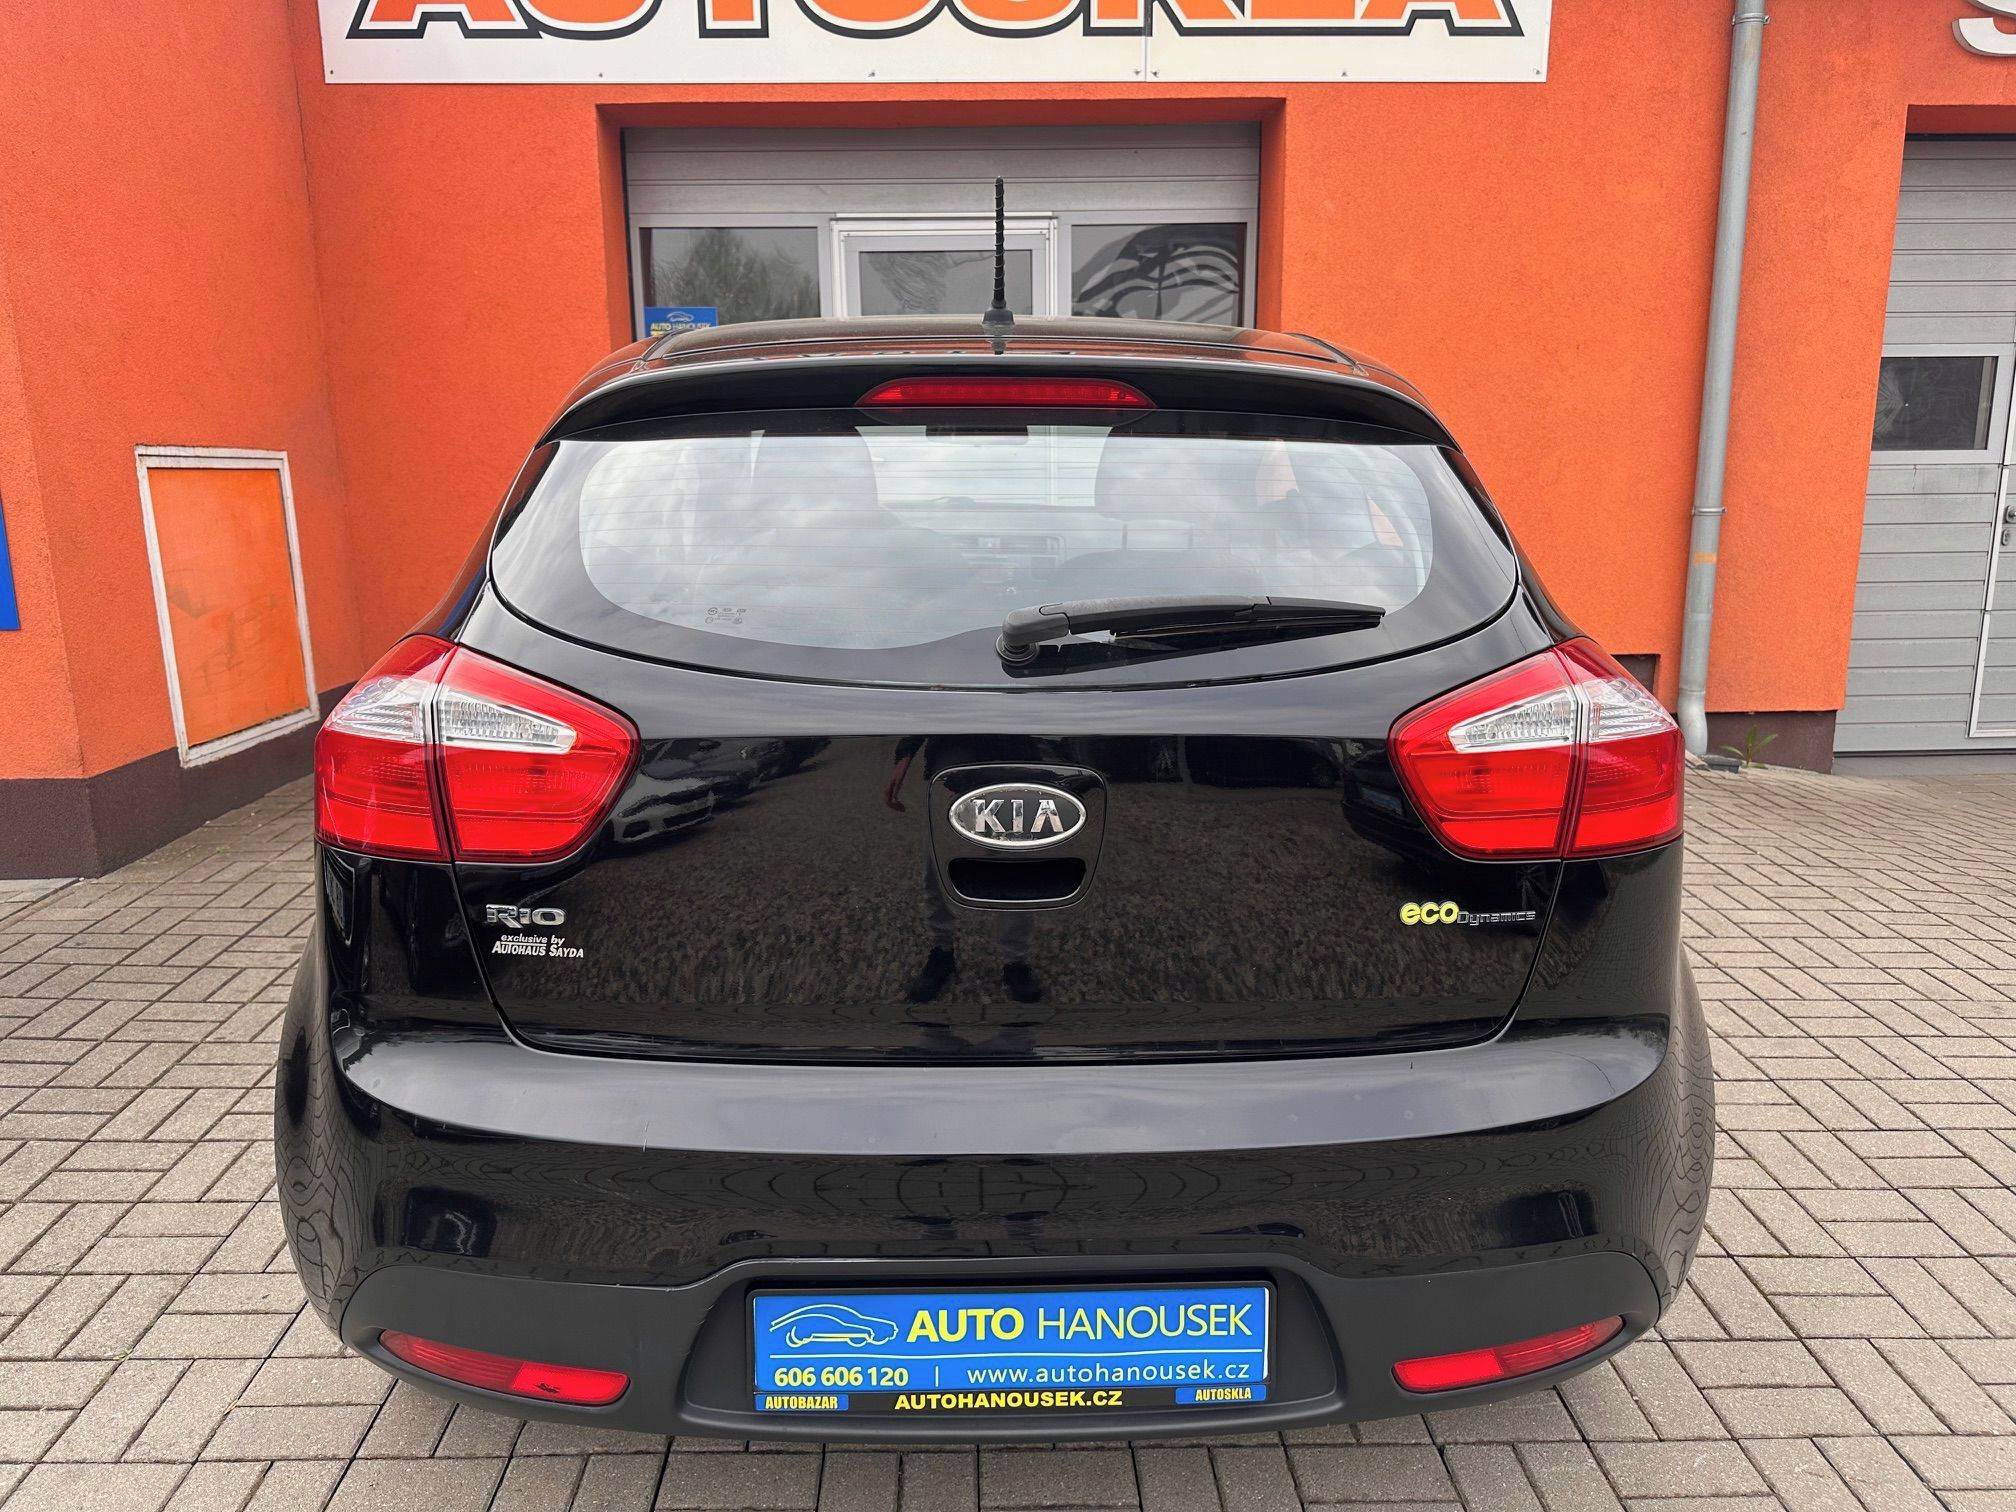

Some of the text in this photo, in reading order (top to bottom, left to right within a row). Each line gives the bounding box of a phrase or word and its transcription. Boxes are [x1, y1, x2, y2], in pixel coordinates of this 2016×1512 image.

[972, 799, 1064, 833] KIA
[501, 933, 565, 947] exclusive by
[906, 1303, 1253, 1343] AUTO HANOUSEK
[774, 1359, 1250, 1387] 606 606 120 www.autohanousek.cz
[765, 1396, 838, 1409] AUTOBAZAR
[894, 1390, 1123, 1410] AUTOHANOUSEK.CZ
[1195, 1387, 1252, 1401] AUTOSKLA
